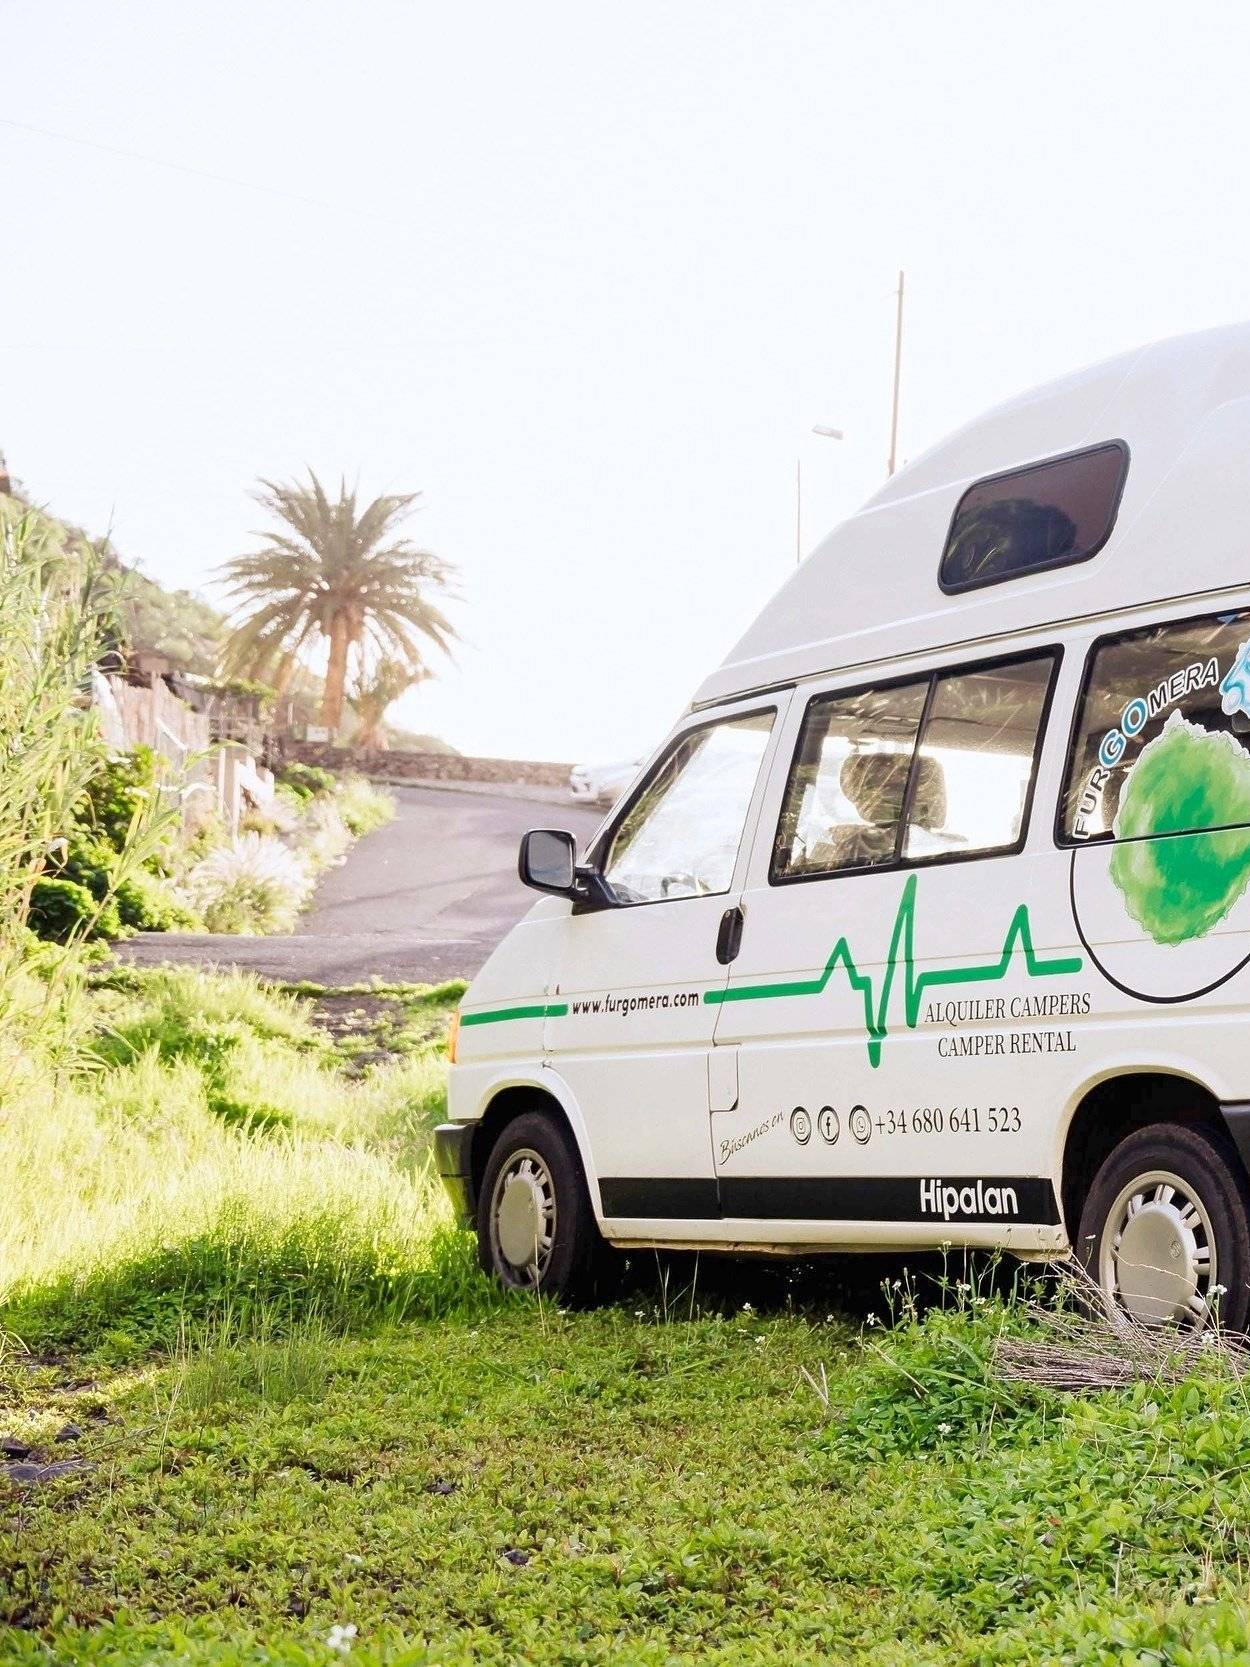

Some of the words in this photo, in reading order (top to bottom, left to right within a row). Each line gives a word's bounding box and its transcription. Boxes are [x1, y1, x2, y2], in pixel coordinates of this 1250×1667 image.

[1073, 658, 1219, 838] FURGOMERA
[572, 992, 699, 1016] www.furgomera.com
[925, 998, 1006, 1026] ALQUILER
[1010, 993, 1091, 1018] CAMPERS
[938, 1034, 1006, 1057] CAMPER
[1010, 1031, 1077, 1053] RENTAL
[875, 1109, 907, 1134] +34
[912, 1107, 944, 1133] 680
[949, 1107, 981, 1133] 641
[988, 1107, 1022, 1133] 523
[920, 1179, 1019, 1221] Hipalan
